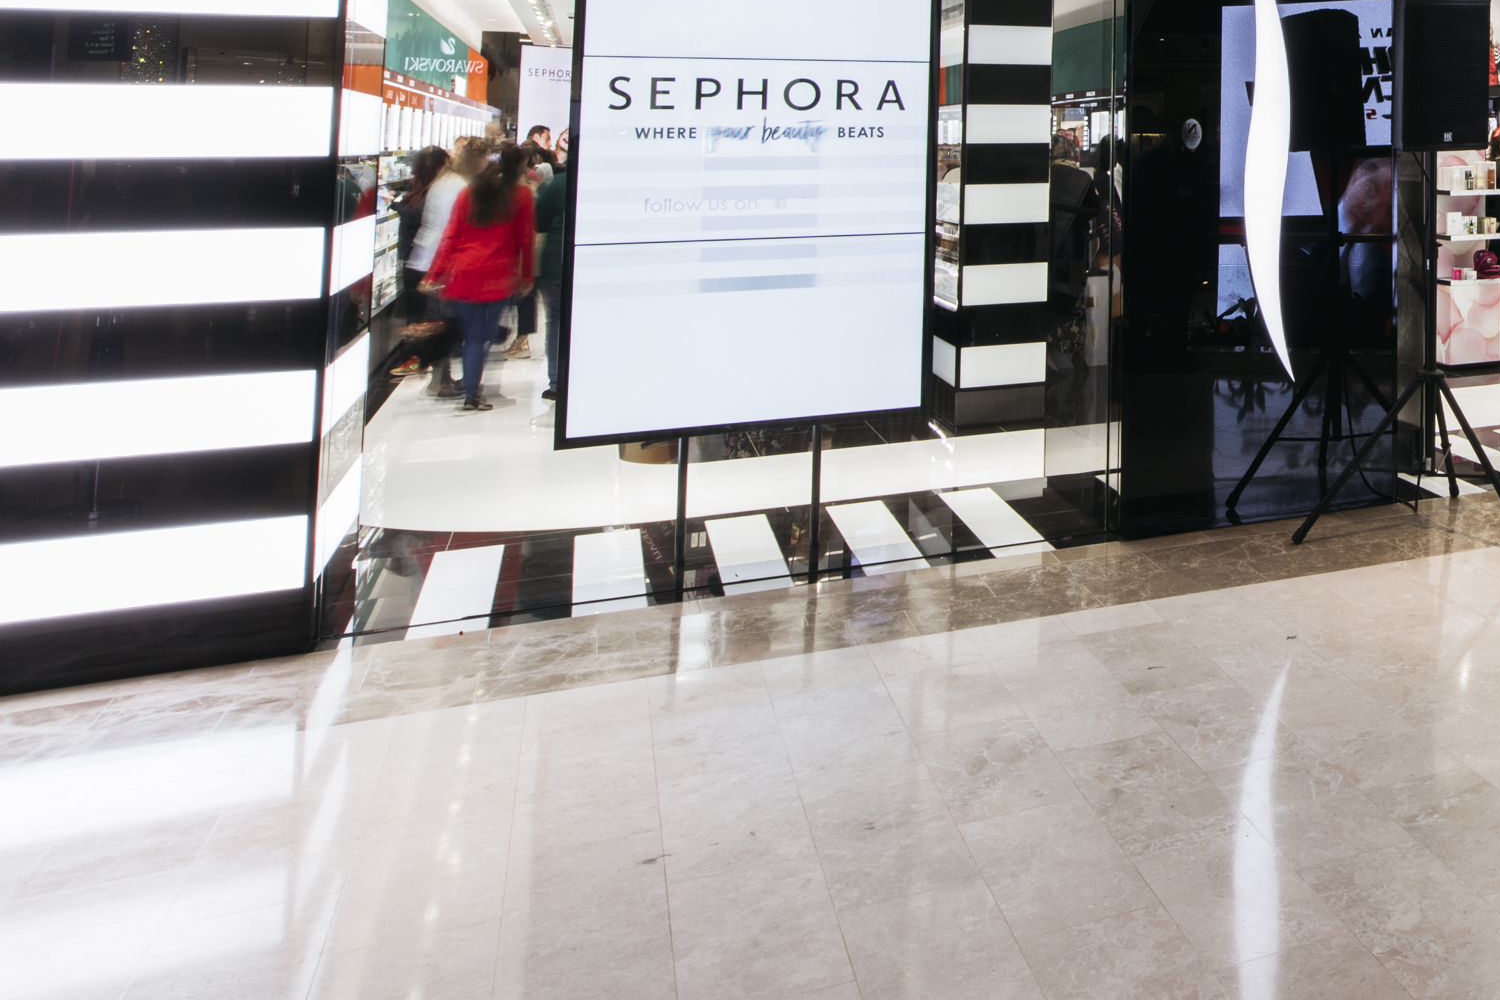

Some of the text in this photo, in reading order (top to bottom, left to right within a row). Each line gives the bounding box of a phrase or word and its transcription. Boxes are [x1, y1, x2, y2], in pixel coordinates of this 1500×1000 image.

[607, 75, 906, 112] SEPHORA
[635, 116, 885, 154] WHERE your beauty BEATS
[643, 198, 758, 213] follow us on
